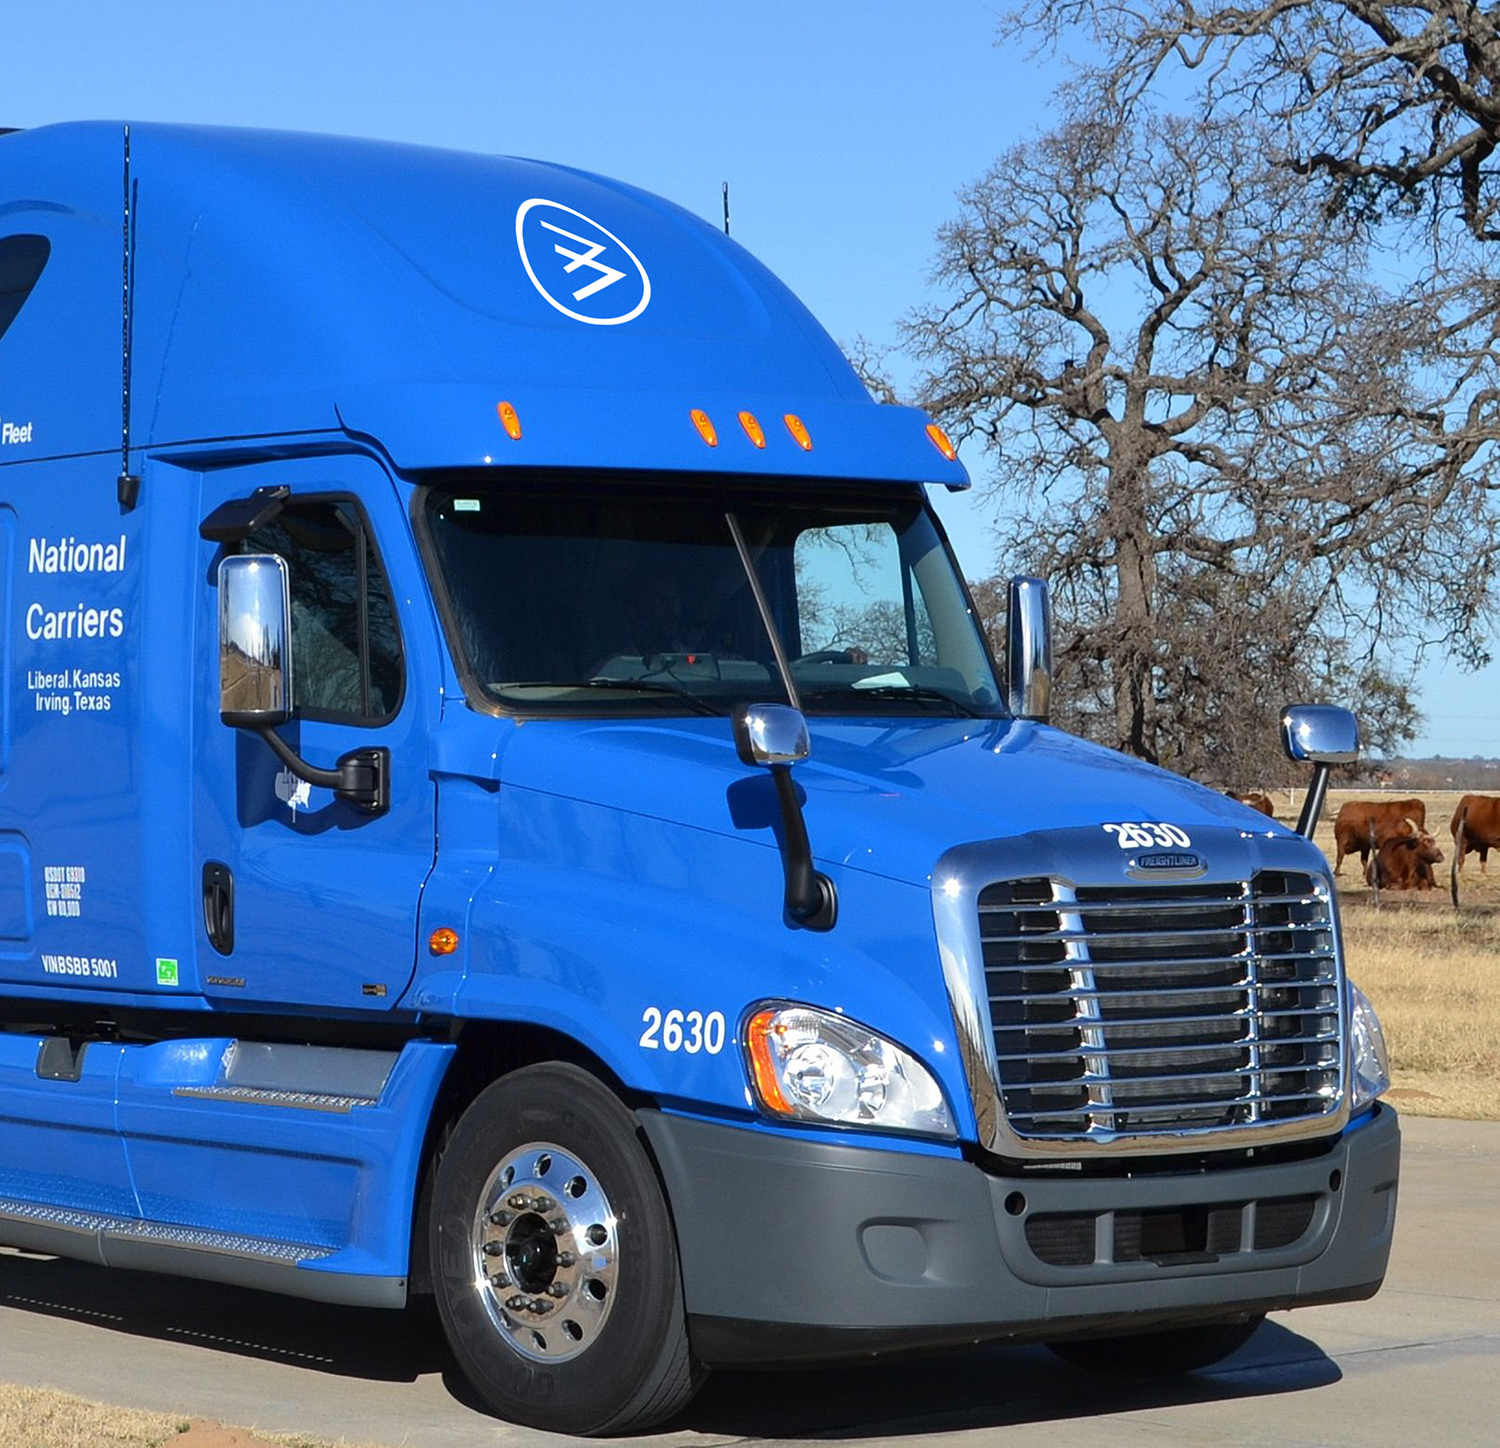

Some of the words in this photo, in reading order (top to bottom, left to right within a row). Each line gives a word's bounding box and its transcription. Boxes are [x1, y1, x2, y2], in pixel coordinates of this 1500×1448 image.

[2, 421, 33, 445] Fleet
[28, 534, 126, 574] National
[26, 602, 124, 640] Carriers
[73, 668, 121, 689] Kansas
[73, 691, 112, 711] Texas
[1102, 822, 1192, 849] 2630
[1140, 855, 1197, 867] FREIGHTLINER
[90, 958, 118, 978] 5001
[638, 1006, 726, 1055] 2630
